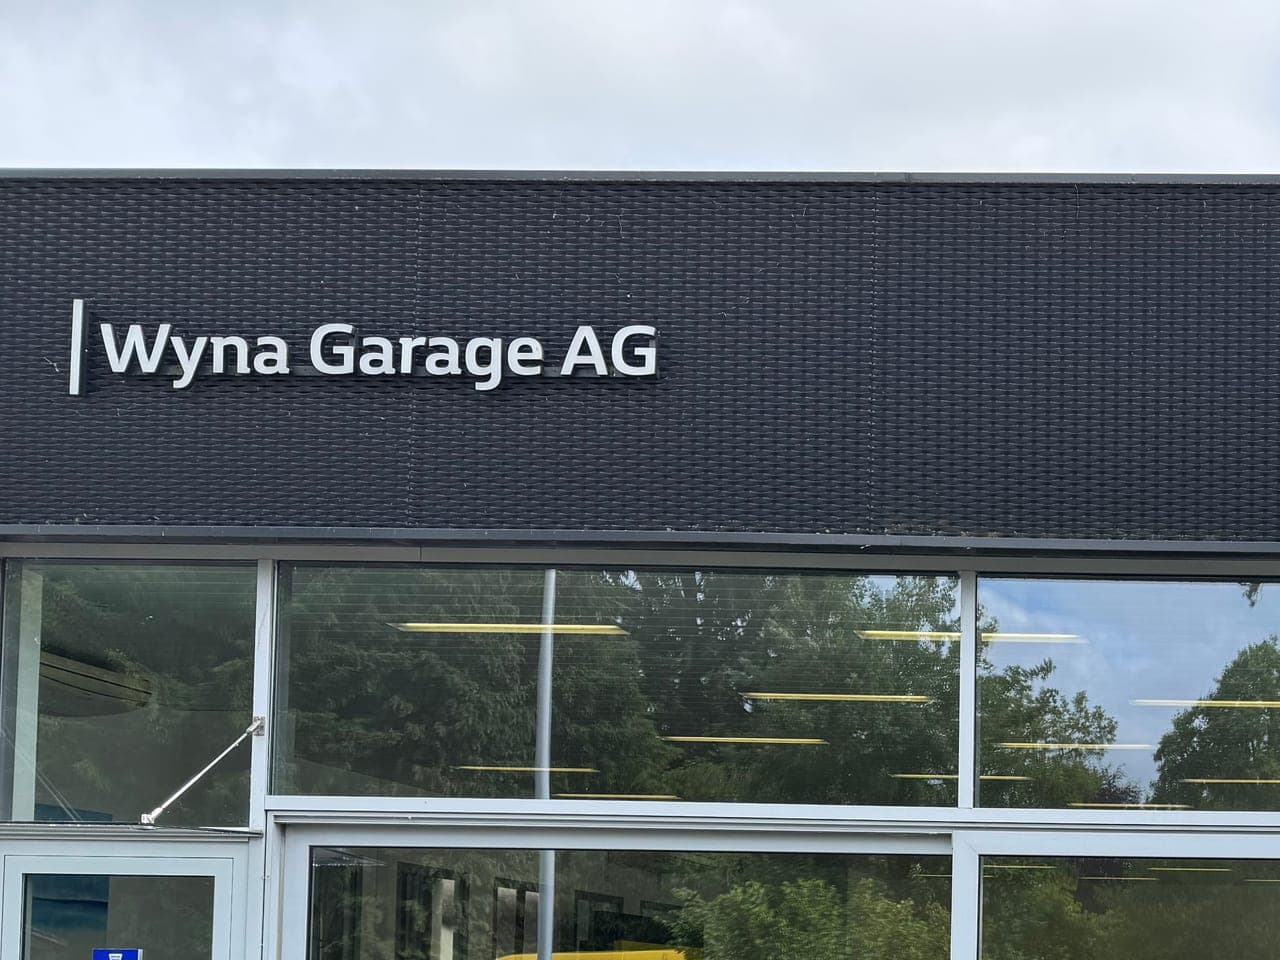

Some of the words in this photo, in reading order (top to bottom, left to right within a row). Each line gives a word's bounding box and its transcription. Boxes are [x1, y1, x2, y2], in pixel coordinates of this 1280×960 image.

[100, 323, 289, 389] Wyna
[310, 323, 544, 391] Garage
[560, 325, 657, 377] AG
